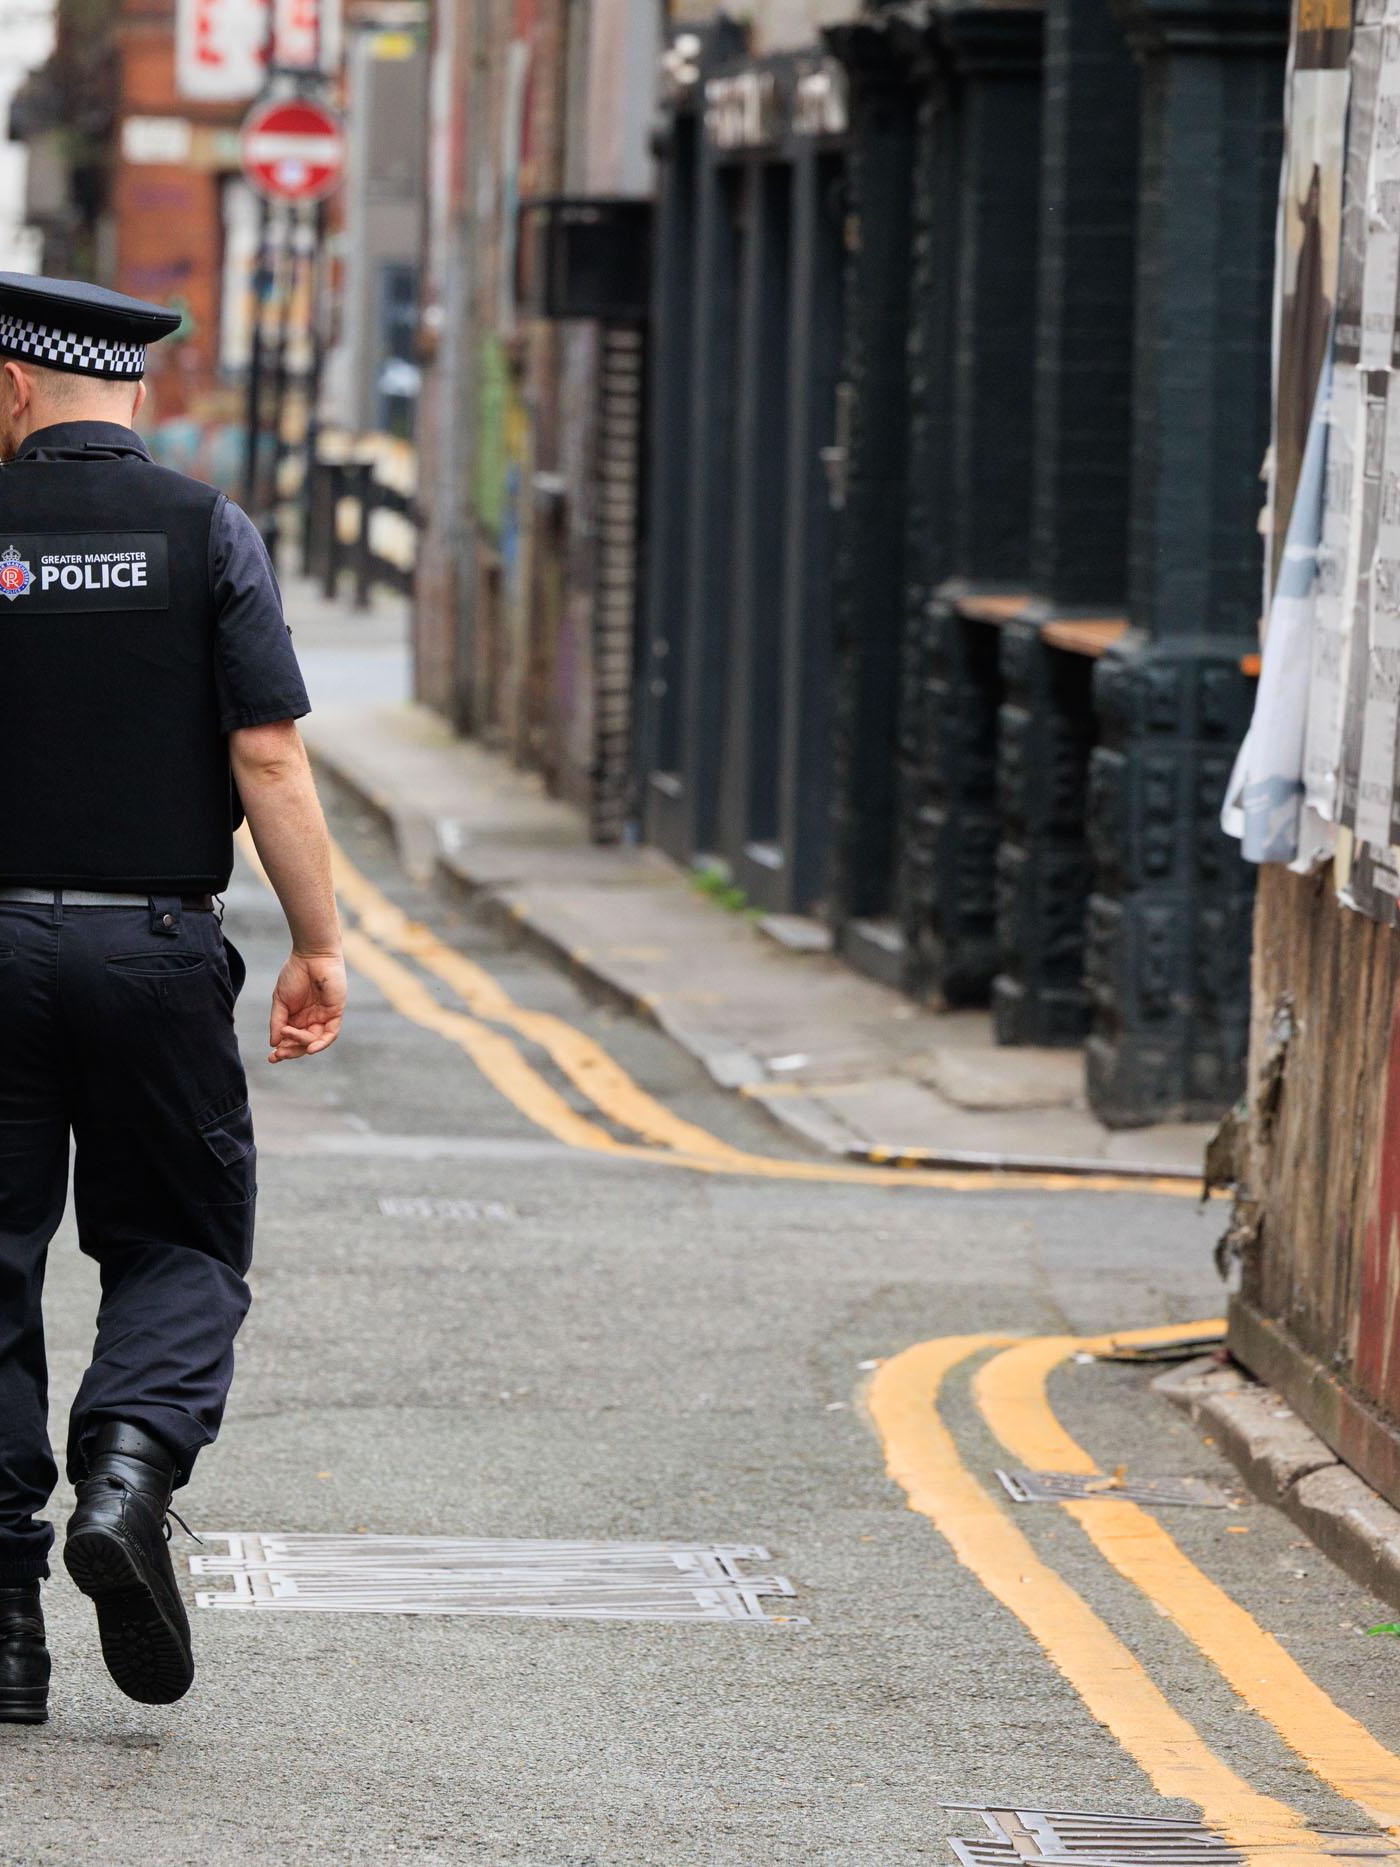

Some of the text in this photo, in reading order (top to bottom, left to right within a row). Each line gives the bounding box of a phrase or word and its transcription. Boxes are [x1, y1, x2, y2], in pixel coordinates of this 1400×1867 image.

[41, 552, 147, 565] GREATER MANCHESTER
[41, 562, 148, 591] POLICE
